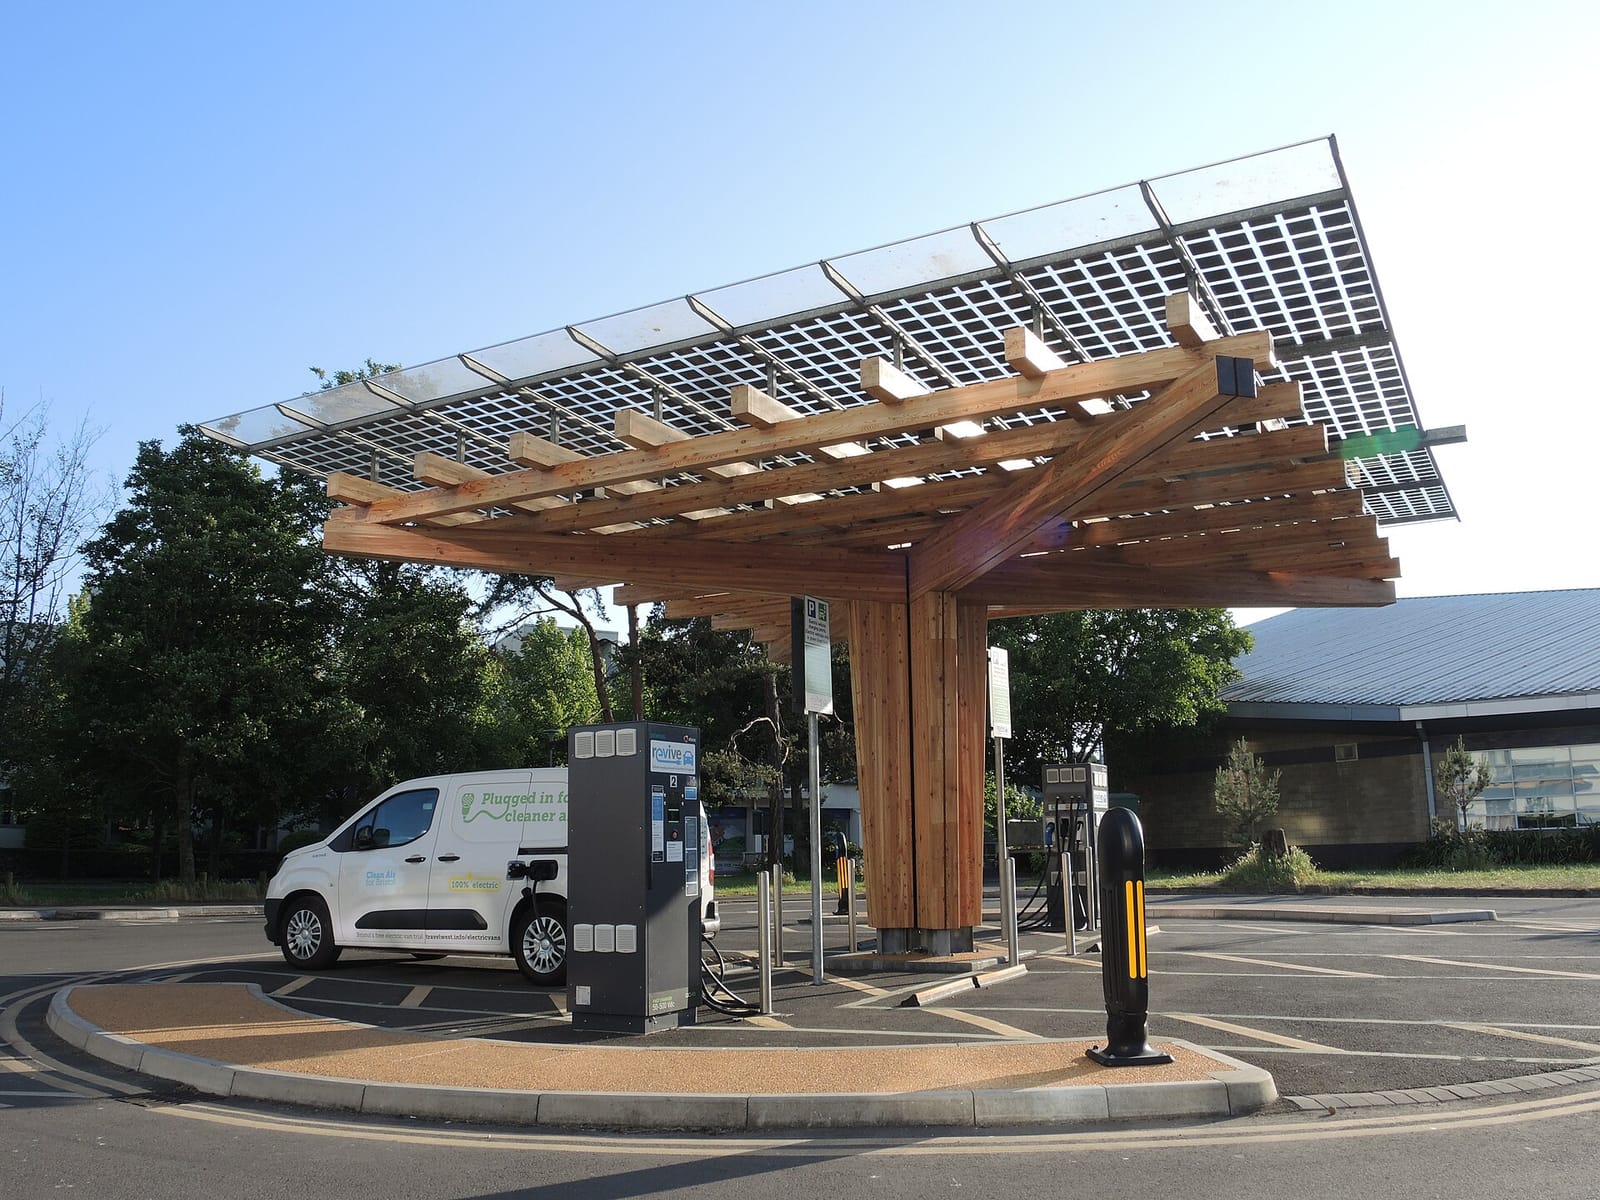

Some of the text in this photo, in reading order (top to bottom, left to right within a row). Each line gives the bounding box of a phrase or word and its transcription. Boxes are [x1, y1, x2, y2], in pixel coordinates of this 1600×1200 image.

[652, 745, 682, 760] revive
[671, 776, 676, 787] 2
[482, 792, 536, 807] Plugged
[540, 792, 553, 804] in
[504, 810, 556, 822] cleaner
[451, 881, 499, 889] 100% electric
